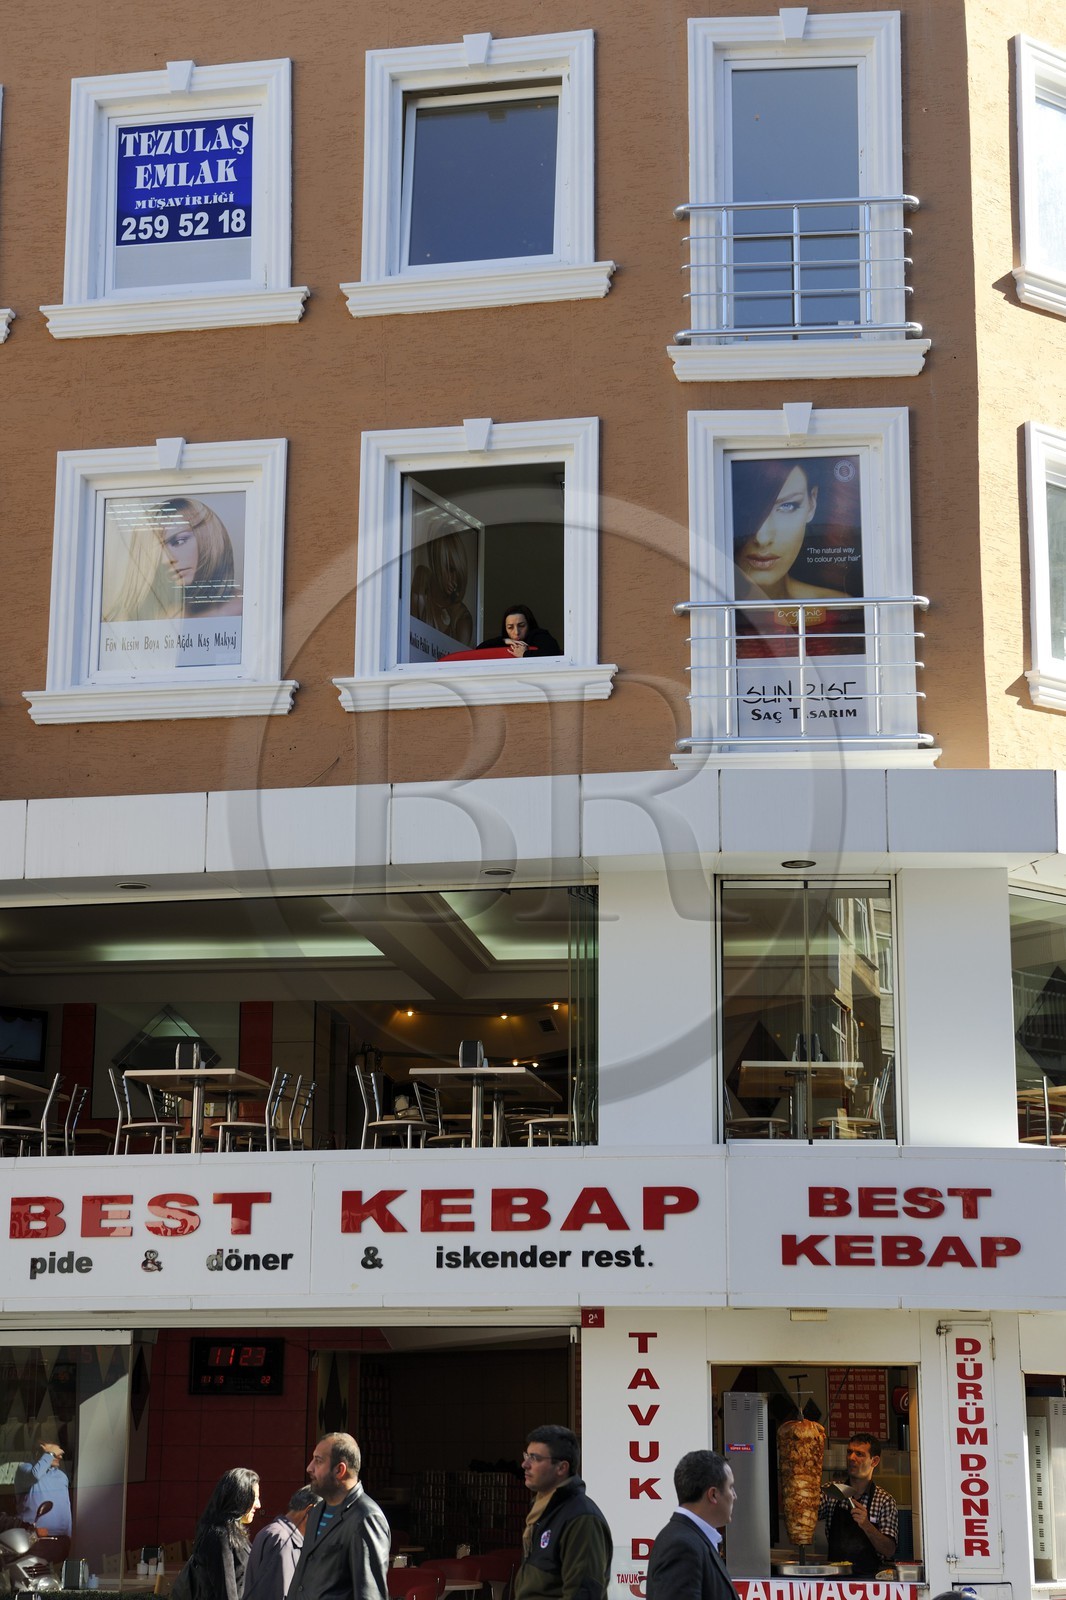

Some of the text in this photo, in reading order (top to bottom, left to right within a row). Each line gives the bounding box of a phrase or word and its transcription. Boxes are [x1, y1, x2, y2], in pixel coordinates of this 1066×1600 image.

[121, 122, 249, 157] TEZULAŞ
[135, 158, 238, 190] EMLAK
[135, 192, 234, 209] MÜŞAVİRLİĞİ
[121, 208, 246, 241] 259 52 18
[777, 608, 822, 625] orgnic
[214, 632, 237, 649] Makyaj
[743, 680, 792, 704] SUN
[789, 707, 857, 719] TSARIM
[9, 1186, 700, 1239] BEST KEBAP
[808, 1186, 992, 1219] BEST
[29, 1244, 654, 1280] pide & döner & iskender rest.
[781, 1234, 1022, 1268] KEBAP
[628, 1332, 662, 1500] TAVUK
[955, 1338, 991, 1557] DÜRÜM DÖNER
[616, 1573, 639, 1584] TAVUK
[738, 1581, 911, 1600] AHMACUN
